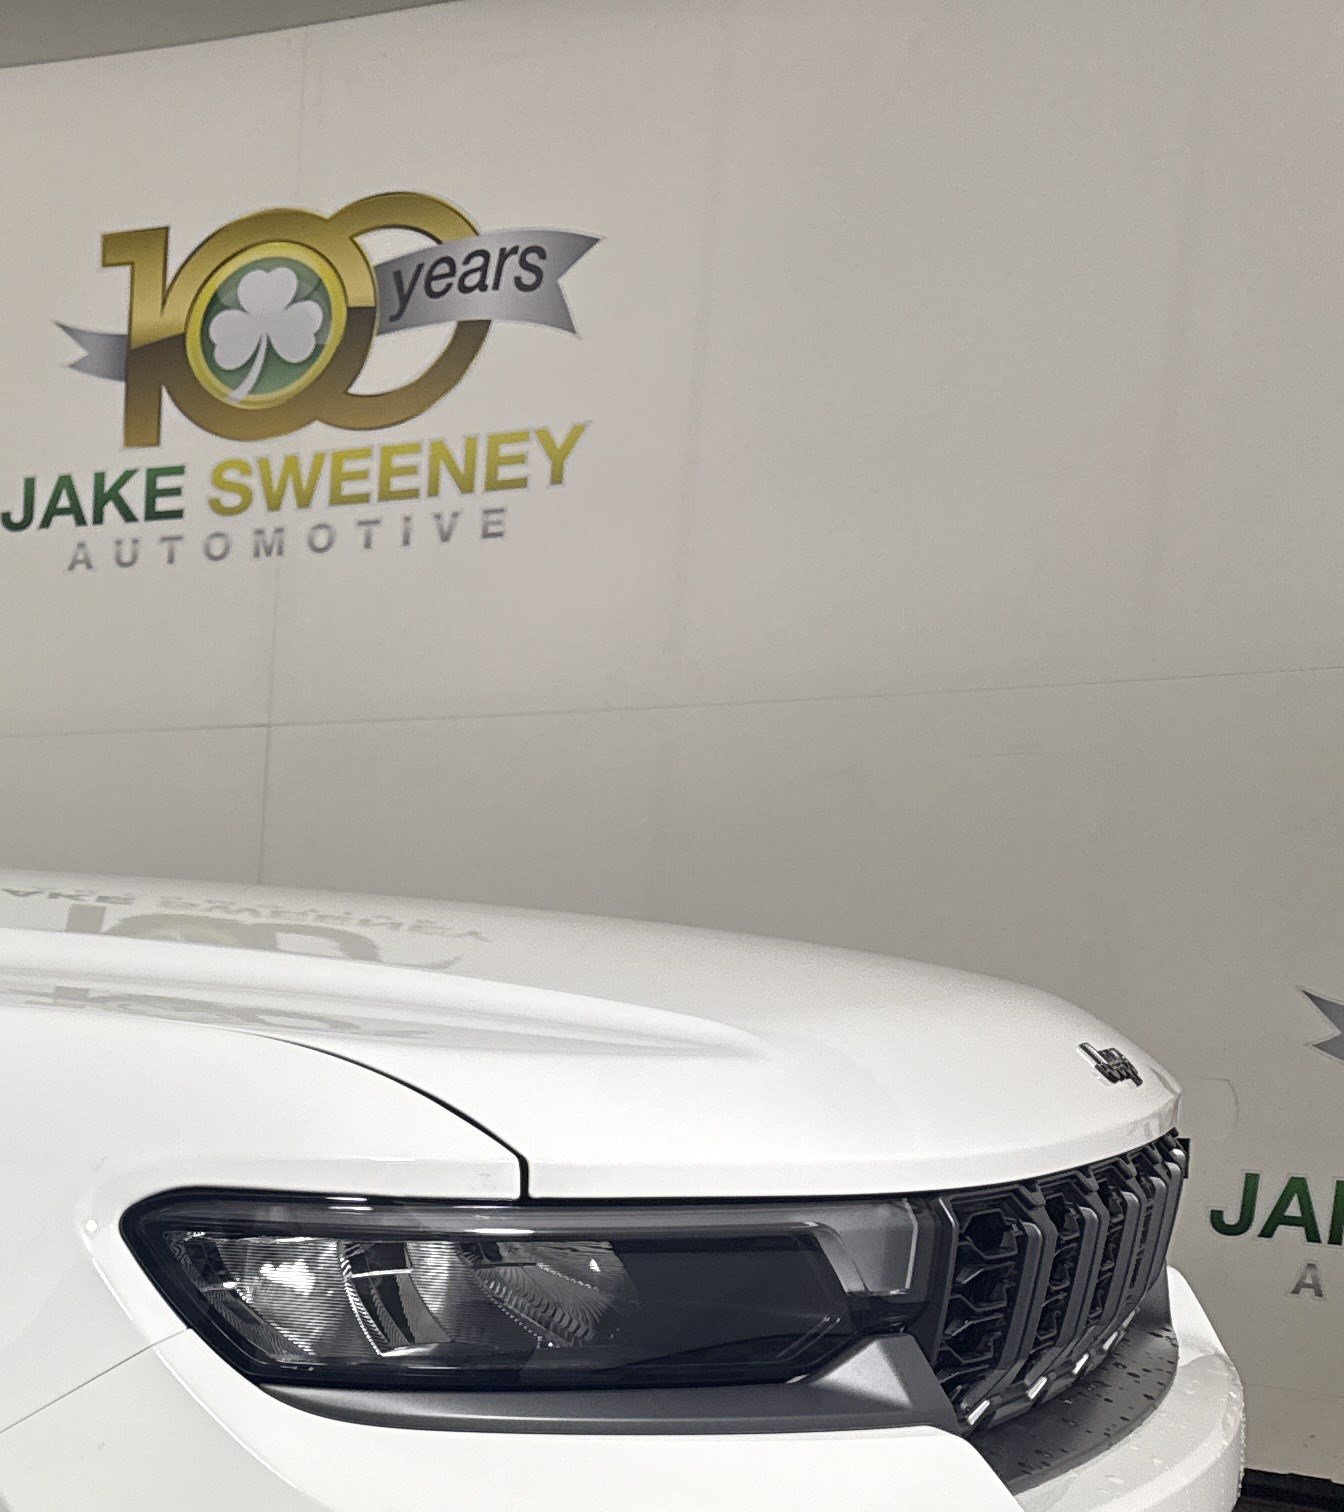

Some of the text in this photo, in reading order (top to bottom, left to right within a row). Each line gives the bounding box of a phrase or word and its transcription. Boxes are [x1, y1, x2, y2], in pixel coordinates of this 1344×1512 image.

[390, 243, 548, 321] years
[0, 422, 590, 533] JAKE SWEENEY
[67, 507, 508, 572] AUTOMOTIVE
